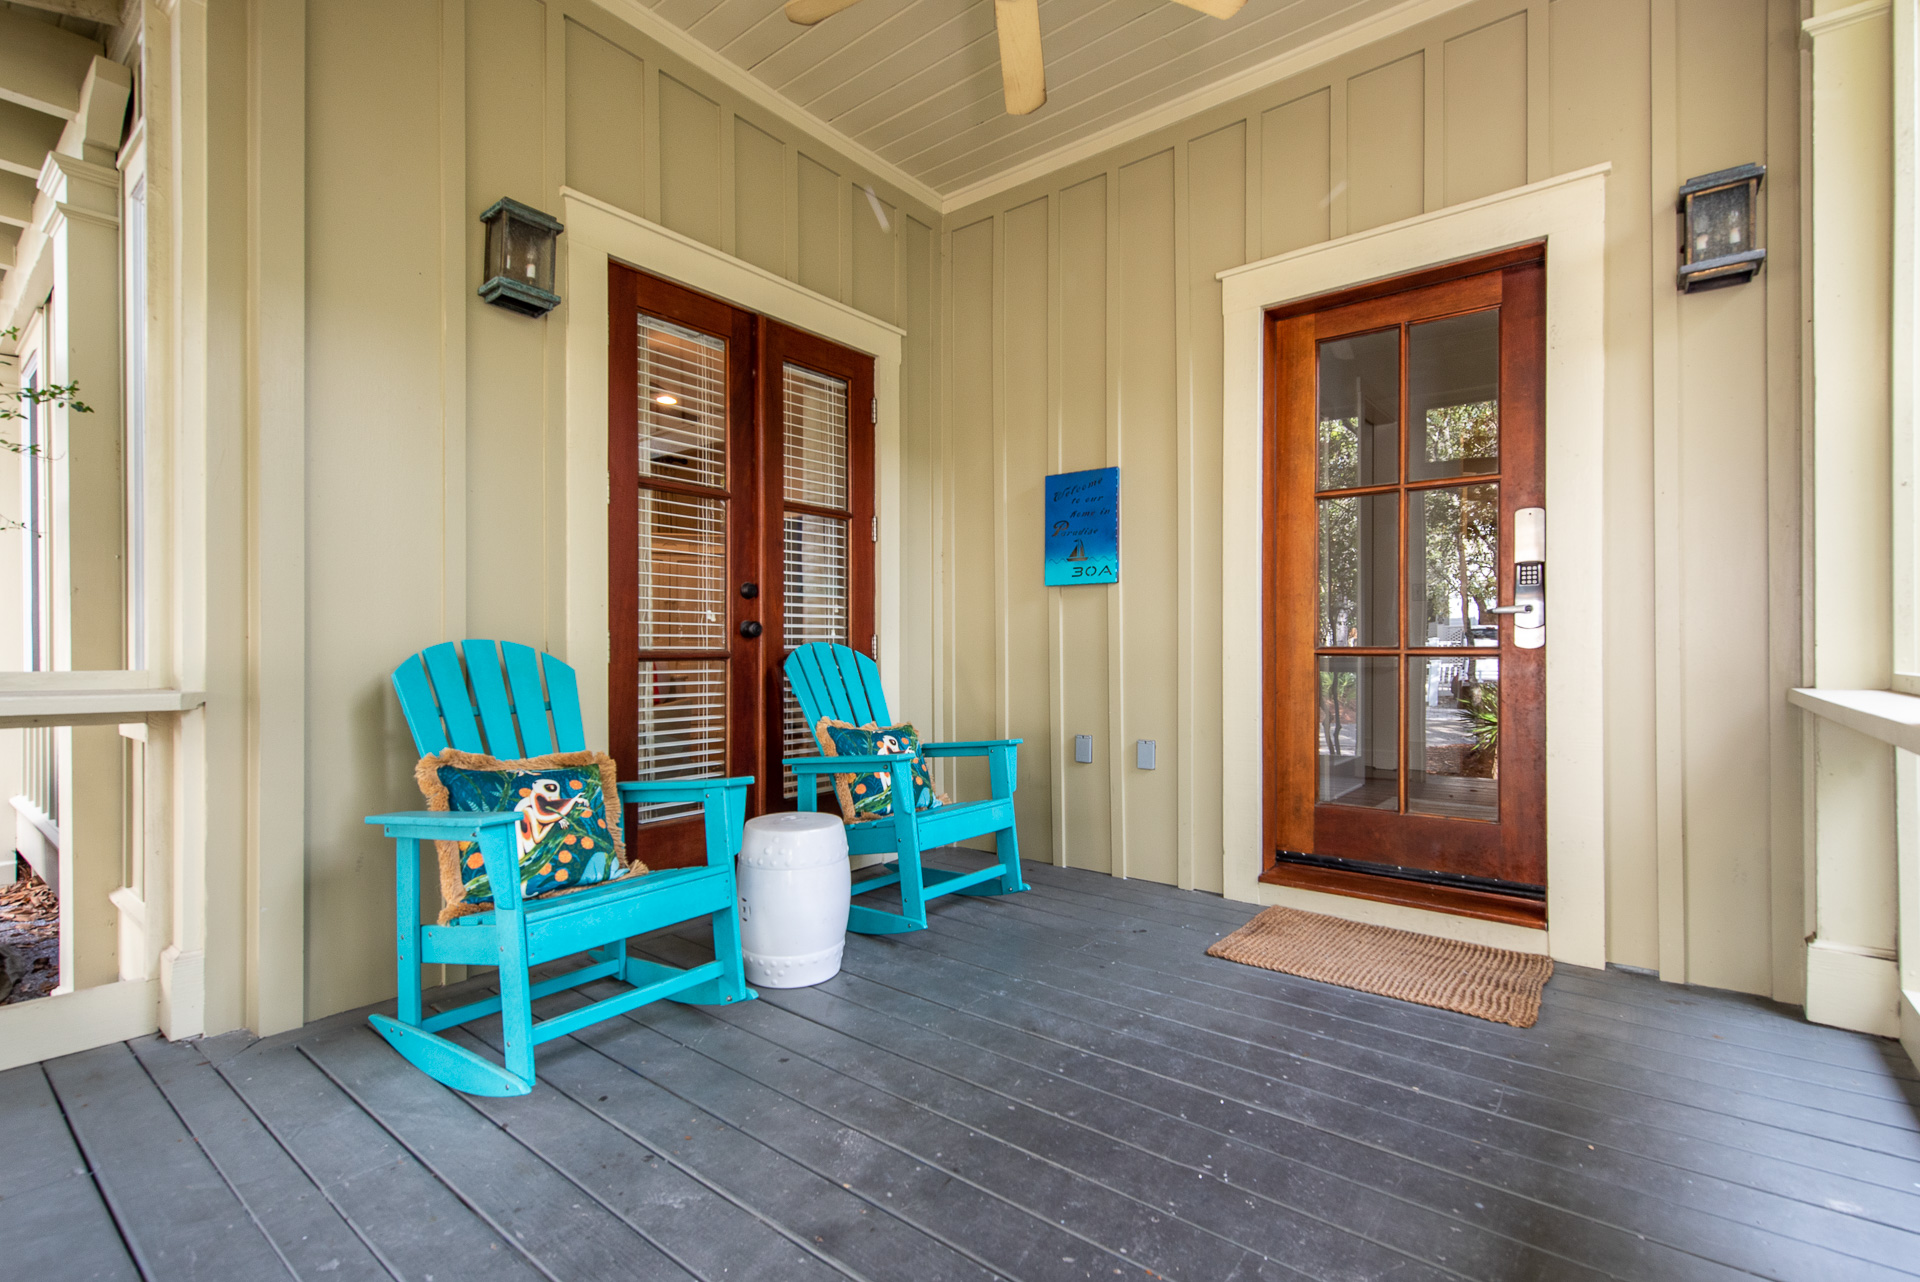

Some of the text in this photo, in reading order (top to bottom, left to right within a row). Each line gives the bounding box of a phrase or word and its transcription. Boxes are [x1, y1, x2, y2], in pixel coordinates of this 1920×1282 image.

[1053, 477, 1103, 502] Welcome
[1071, 495, 1104, 505] to our
[1099, 507, 1111, 516] in
[1051, 520, 1099, 537] Paradise
[1071, 564, 1113, 578] 30A
